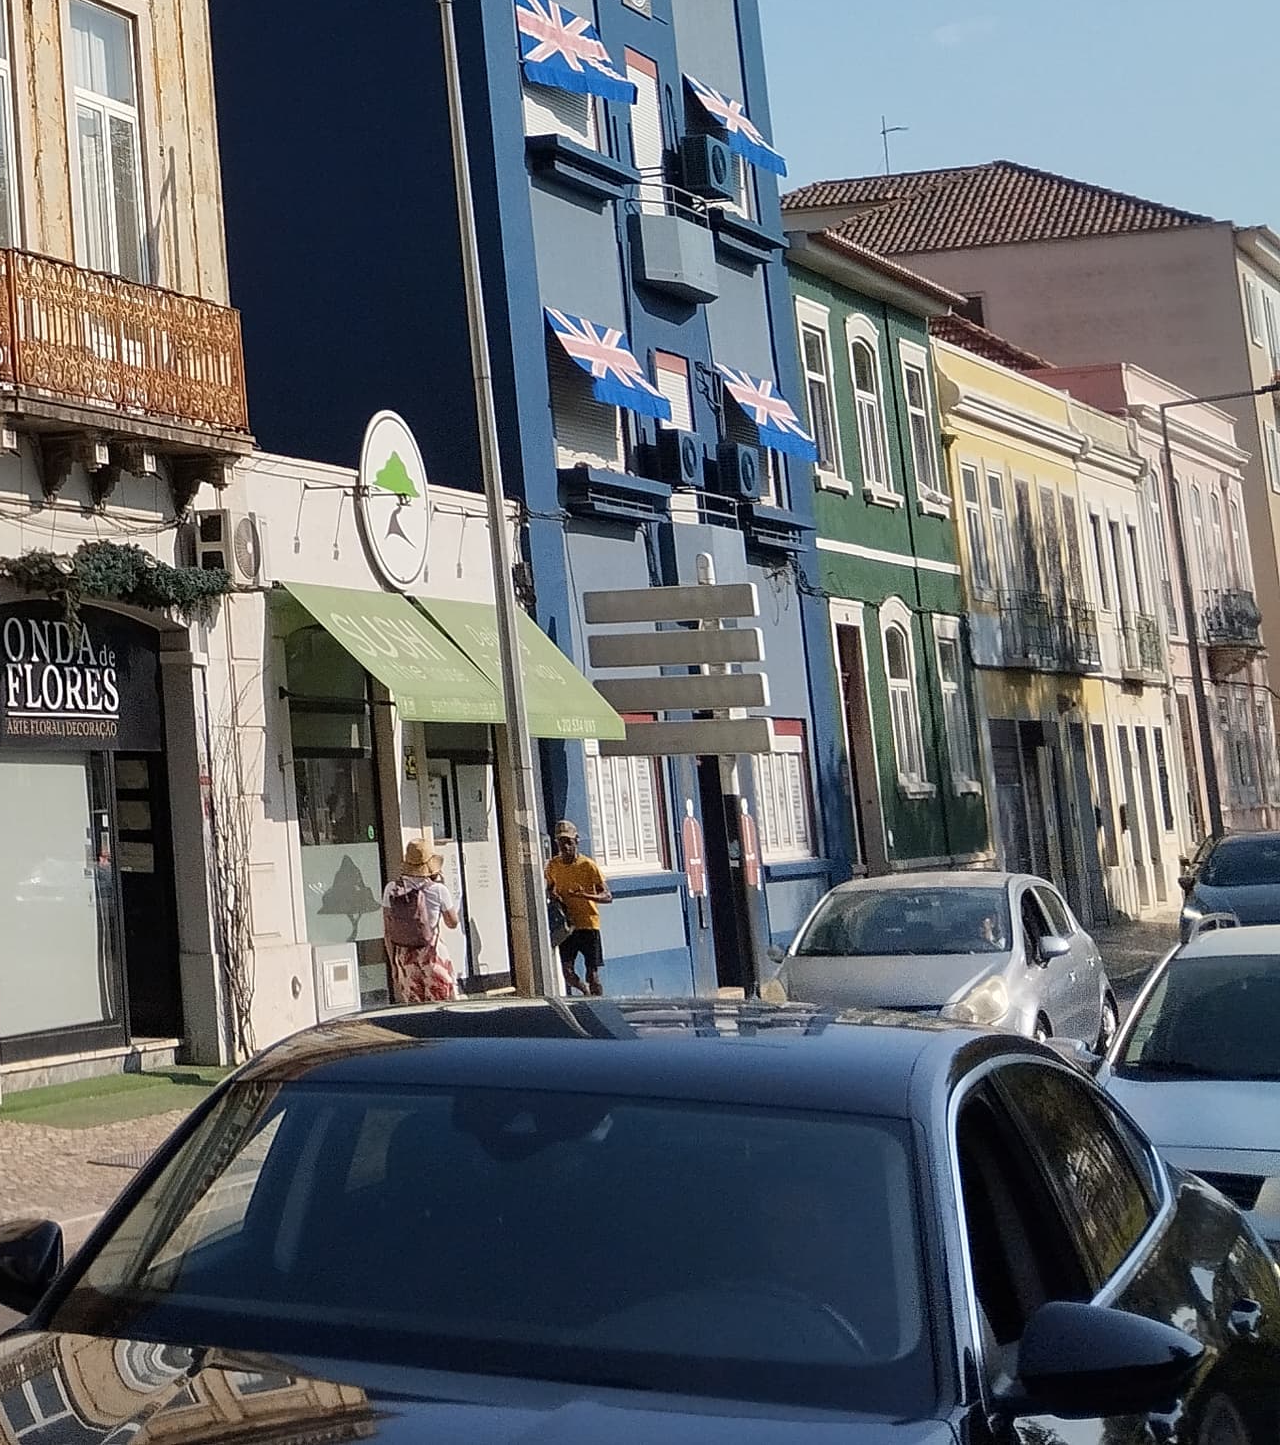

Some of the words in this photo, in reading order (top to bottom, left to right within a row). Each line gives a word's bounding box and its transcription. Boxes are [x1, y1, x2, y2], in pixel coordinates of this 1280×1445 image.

[4, 617, 98, 665] ONDA
[100, 644, 116, 667] de
[330, 612, 447, 661] SUSHI
[6, 663, 120, 711] FLORES
[7, 720, 30, 734] ARTE
[31, 720, 60, 735] FLORAL
[66, 720, 117, 738] DECORAÇÃO
